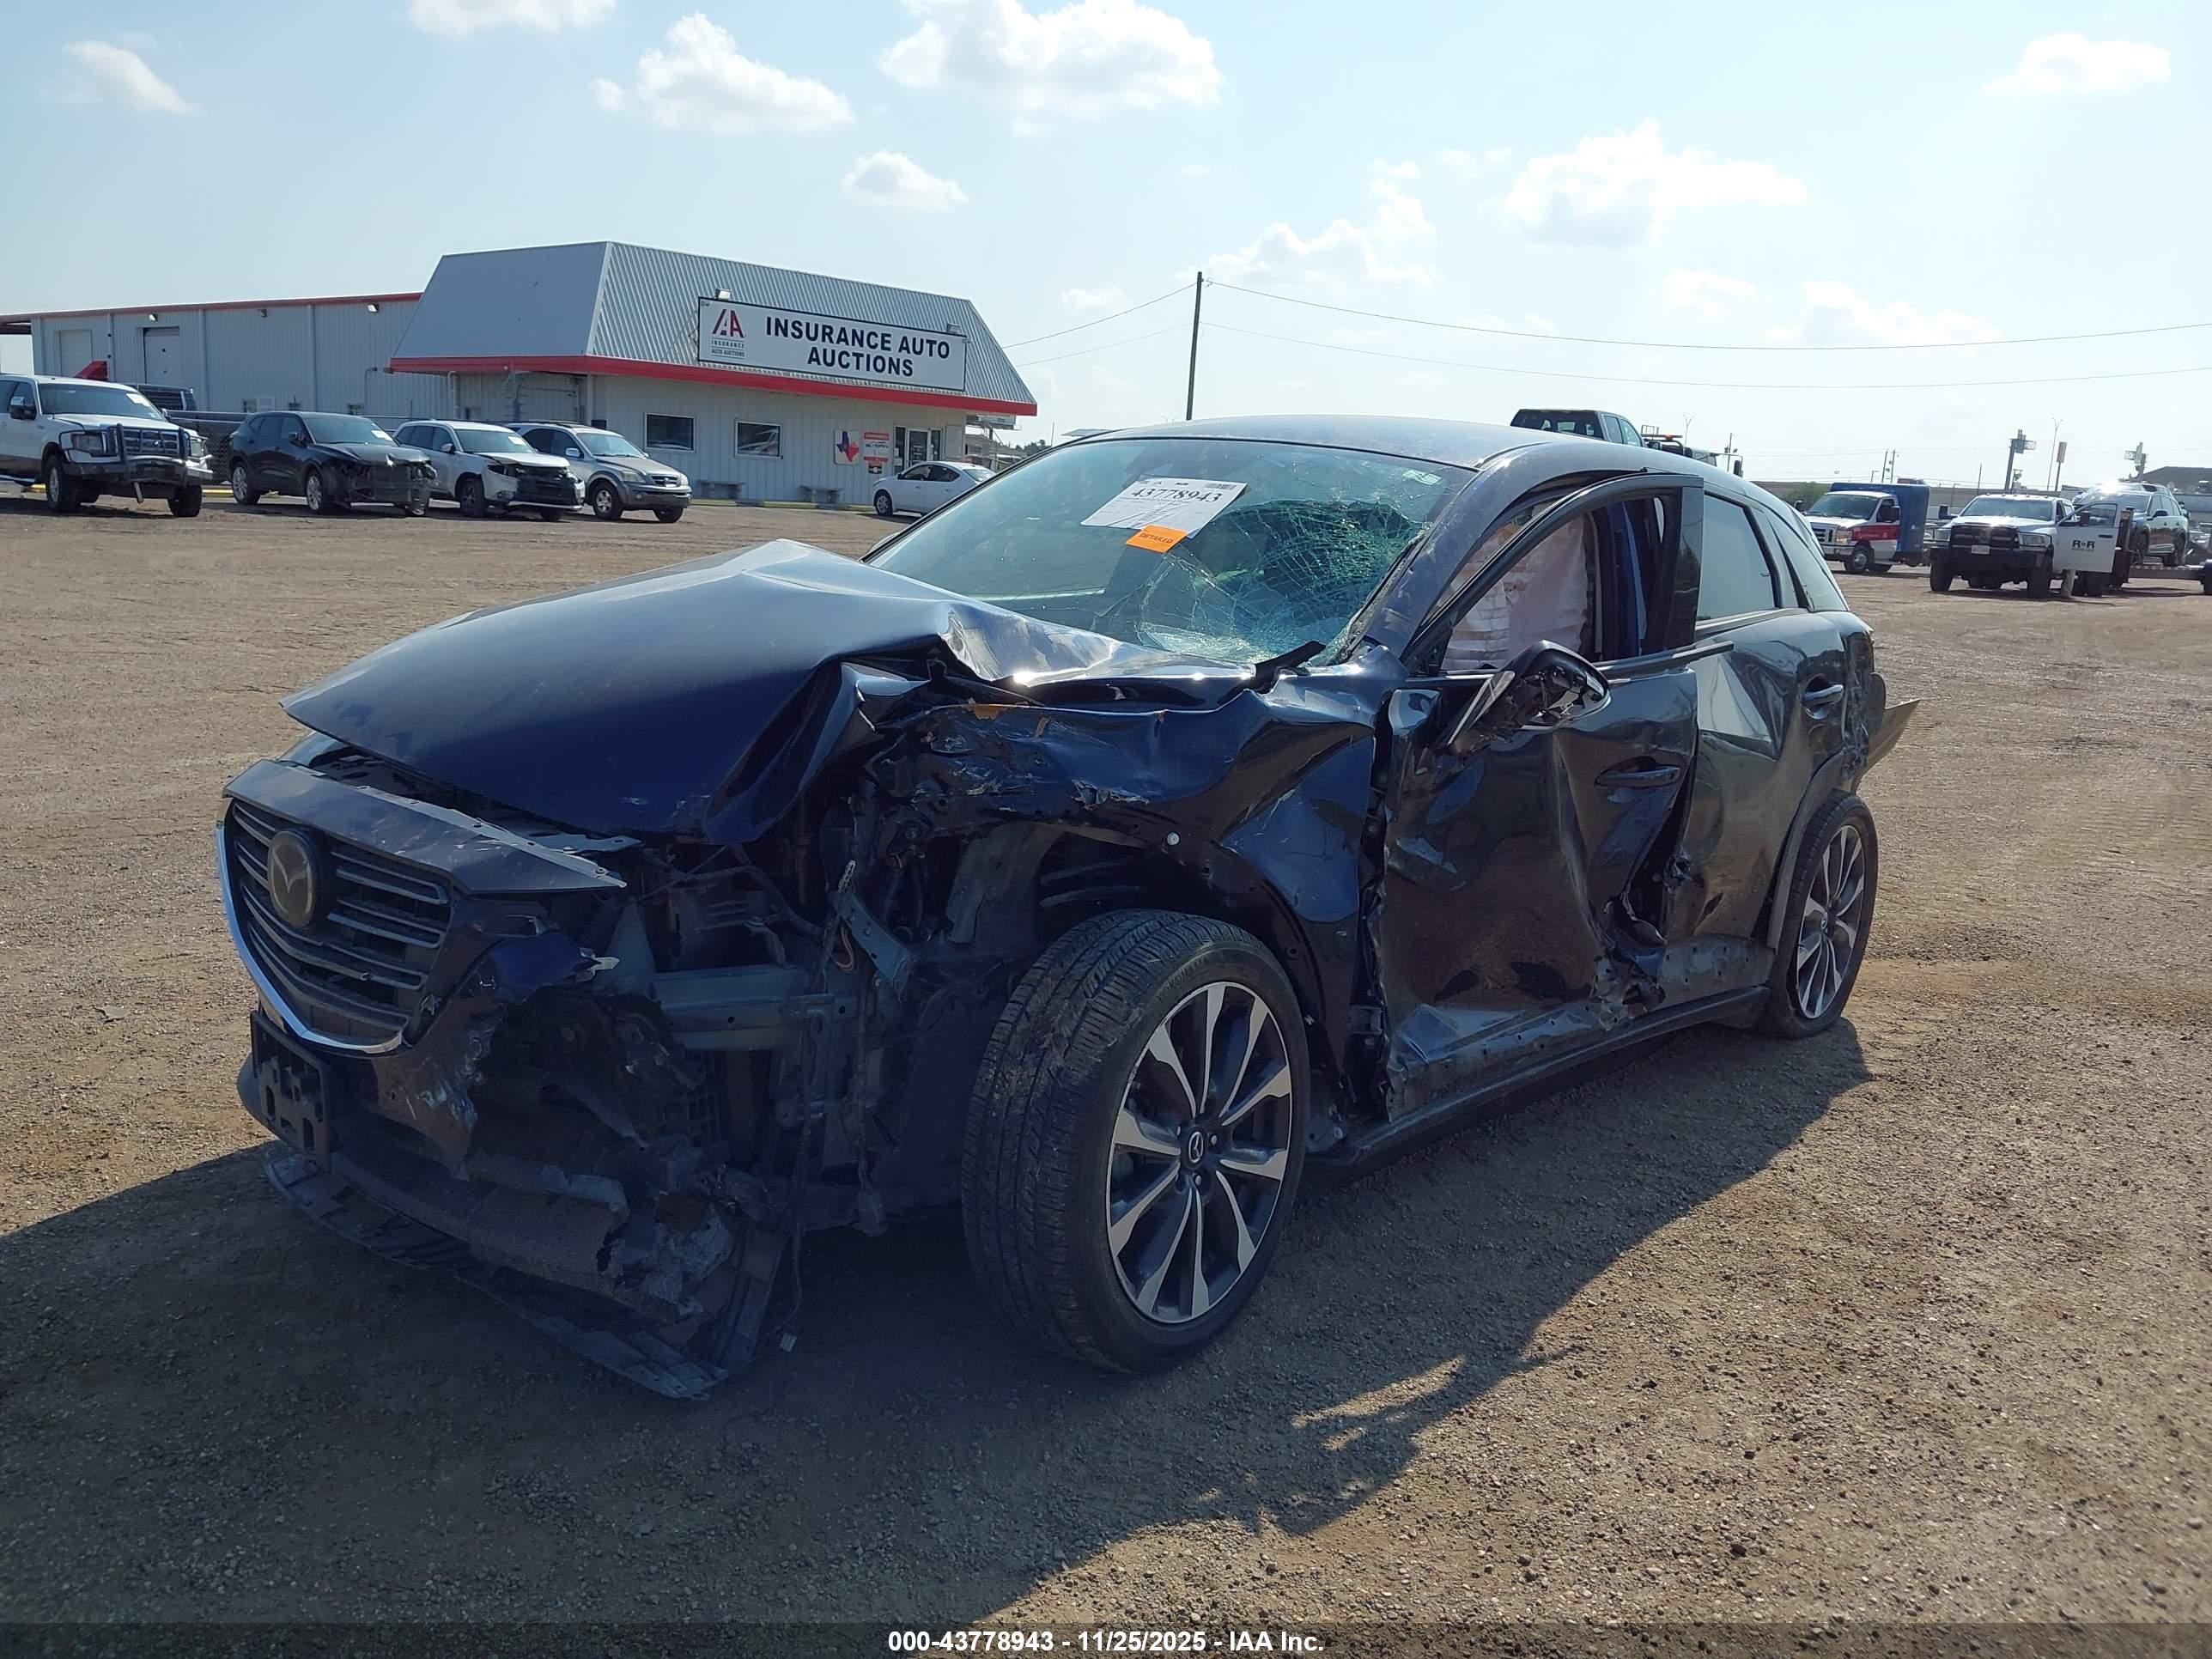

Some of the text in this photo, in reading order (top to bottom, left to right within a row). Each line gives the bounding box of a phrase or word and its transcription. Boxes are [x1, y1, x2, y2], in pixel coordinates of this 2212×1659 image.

[711, 339, 744, 349] INSURANCE
[766, 317, 951, 360] INSURANCE AUTO
[807, 346, 914, 377] AUCTIONS
[1131, 488, 1223, 502] 43778943
[1139, 533, 1174, 544] DETAILED
